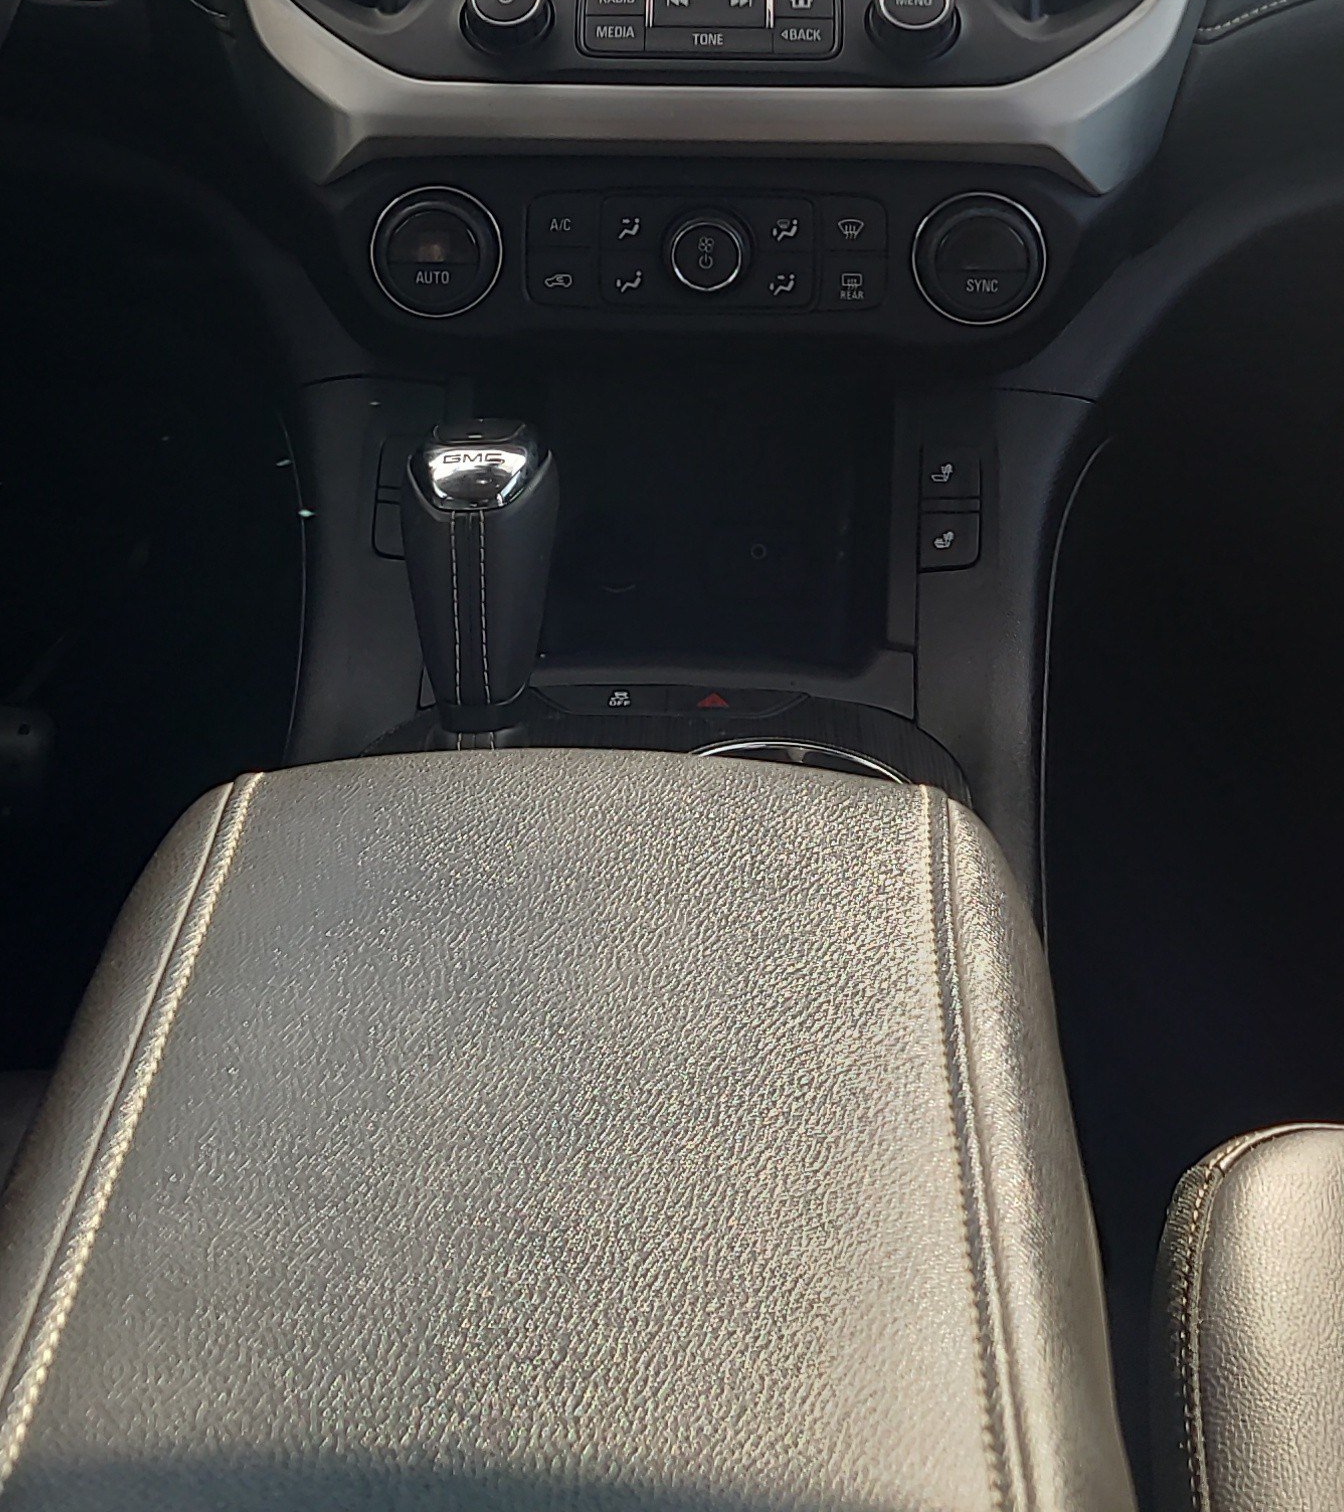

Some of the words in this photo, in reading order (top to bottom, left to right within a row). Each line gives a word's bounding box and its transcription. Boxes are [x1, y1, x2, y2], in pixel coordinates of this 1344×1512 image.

[596, 25, 635, 39] MEDIA
[790, 28, 821, 42] BACK
[692, 32, 724, 47] TONE
[550, 218, 571, 232] A/C
[416, 271, 450, 285] AUTO
[966, 279, 999, 293] SYNC
[840, 290, 864, 300] REAR
[443, 453, 506, 465] GMC
